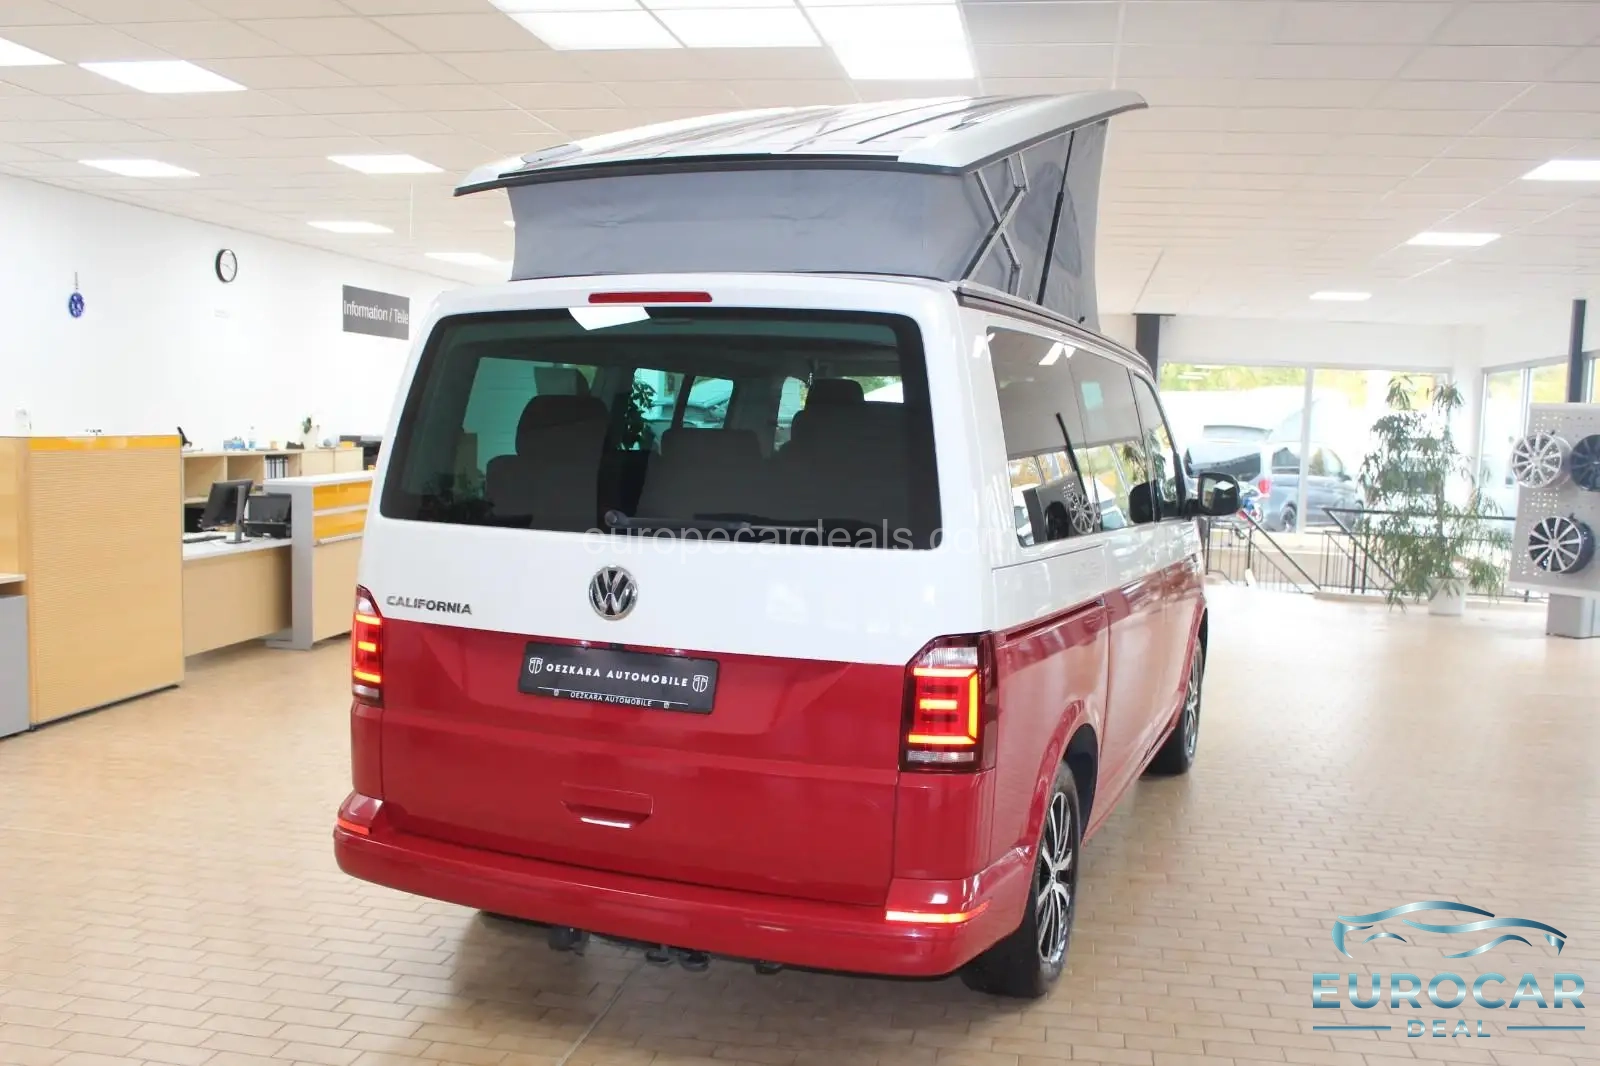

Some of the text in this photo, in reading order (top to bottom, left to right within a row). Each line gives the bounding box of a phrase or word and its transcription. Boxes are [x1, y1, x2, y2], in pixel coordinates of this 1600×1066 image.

[343, 300, 388, 321] Information
[386, 595, 472, 615] CALIFORNIA
[546, 662, 688, 687] OEZKARA AUTOMOBILE
[570, 691, 652, 708] OEZKARA AUTOMOBILE
